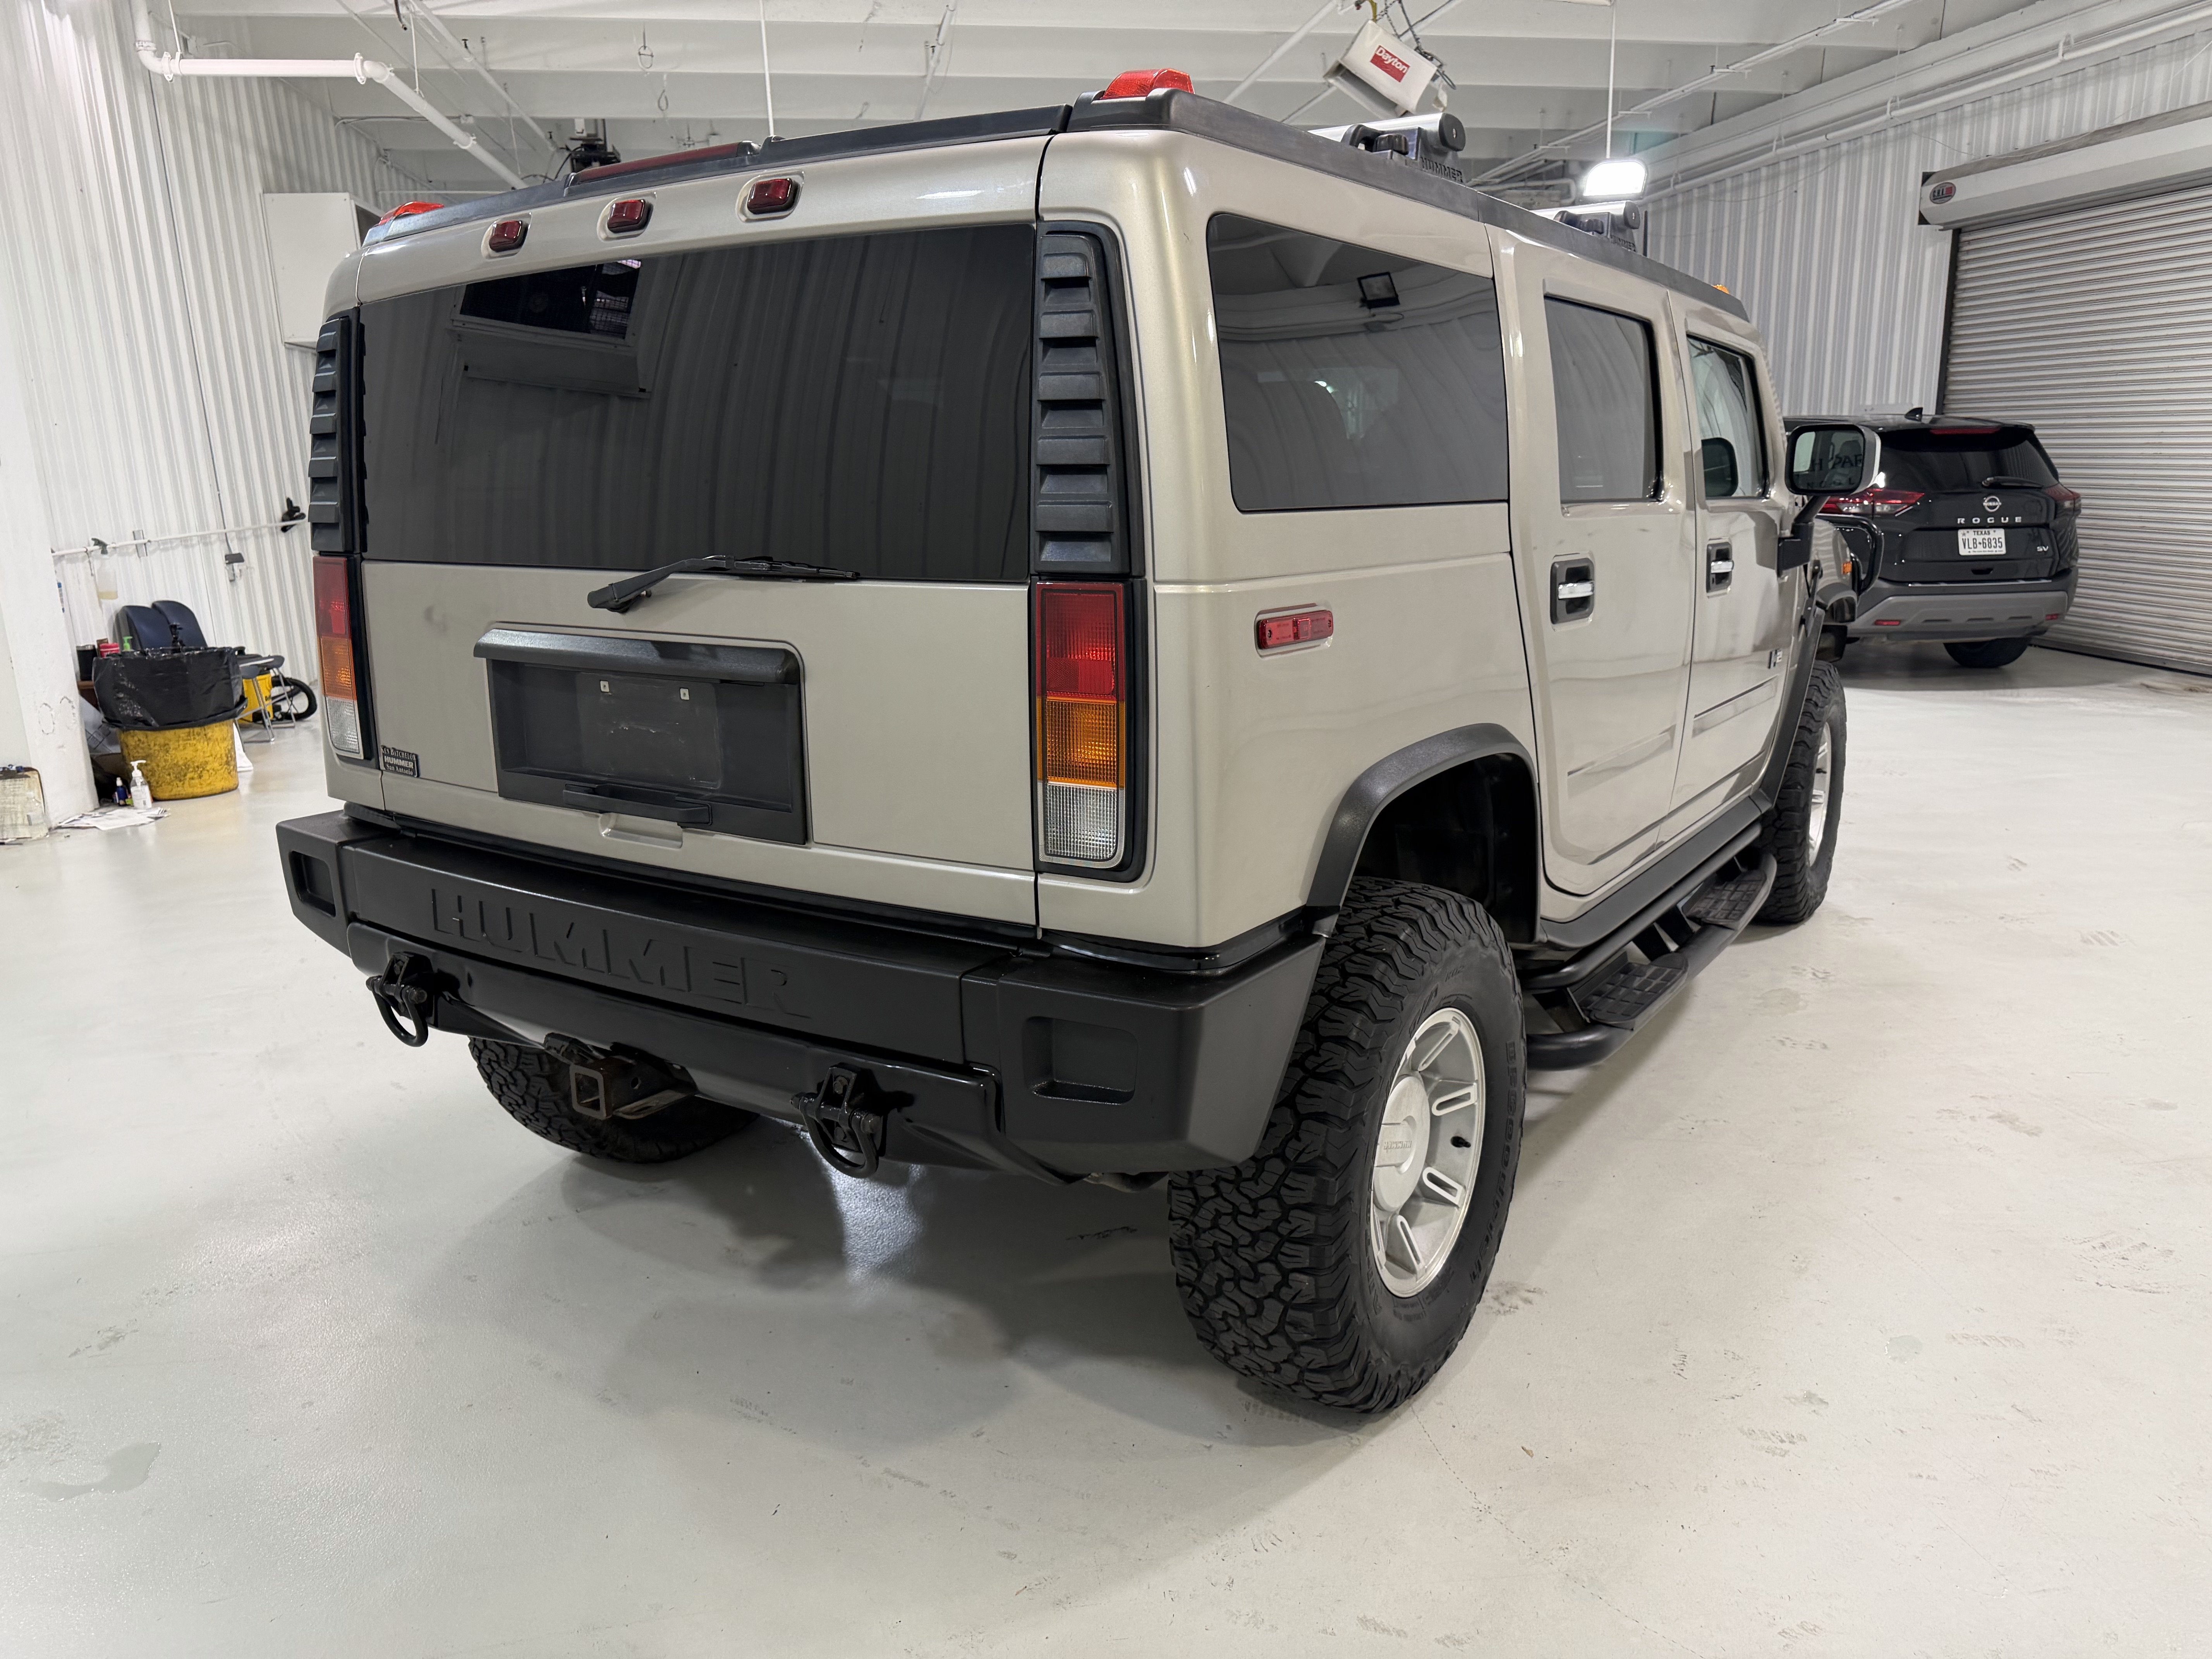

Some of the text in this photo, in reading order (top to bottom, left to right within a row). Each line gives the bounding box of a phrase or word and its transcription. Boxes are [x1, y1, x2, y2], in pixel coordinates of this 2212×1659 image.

[1376, 47, 1408, 73] Dayton
[1420, 156, 1463, 183] HUMMER
[1957, 516, 2022, 524] ROGUE
[384, 755, 414, 769] HUMMER
[395, 766, 413, 776] Antonio
[431, 888, 812, 1019] HUMMER
